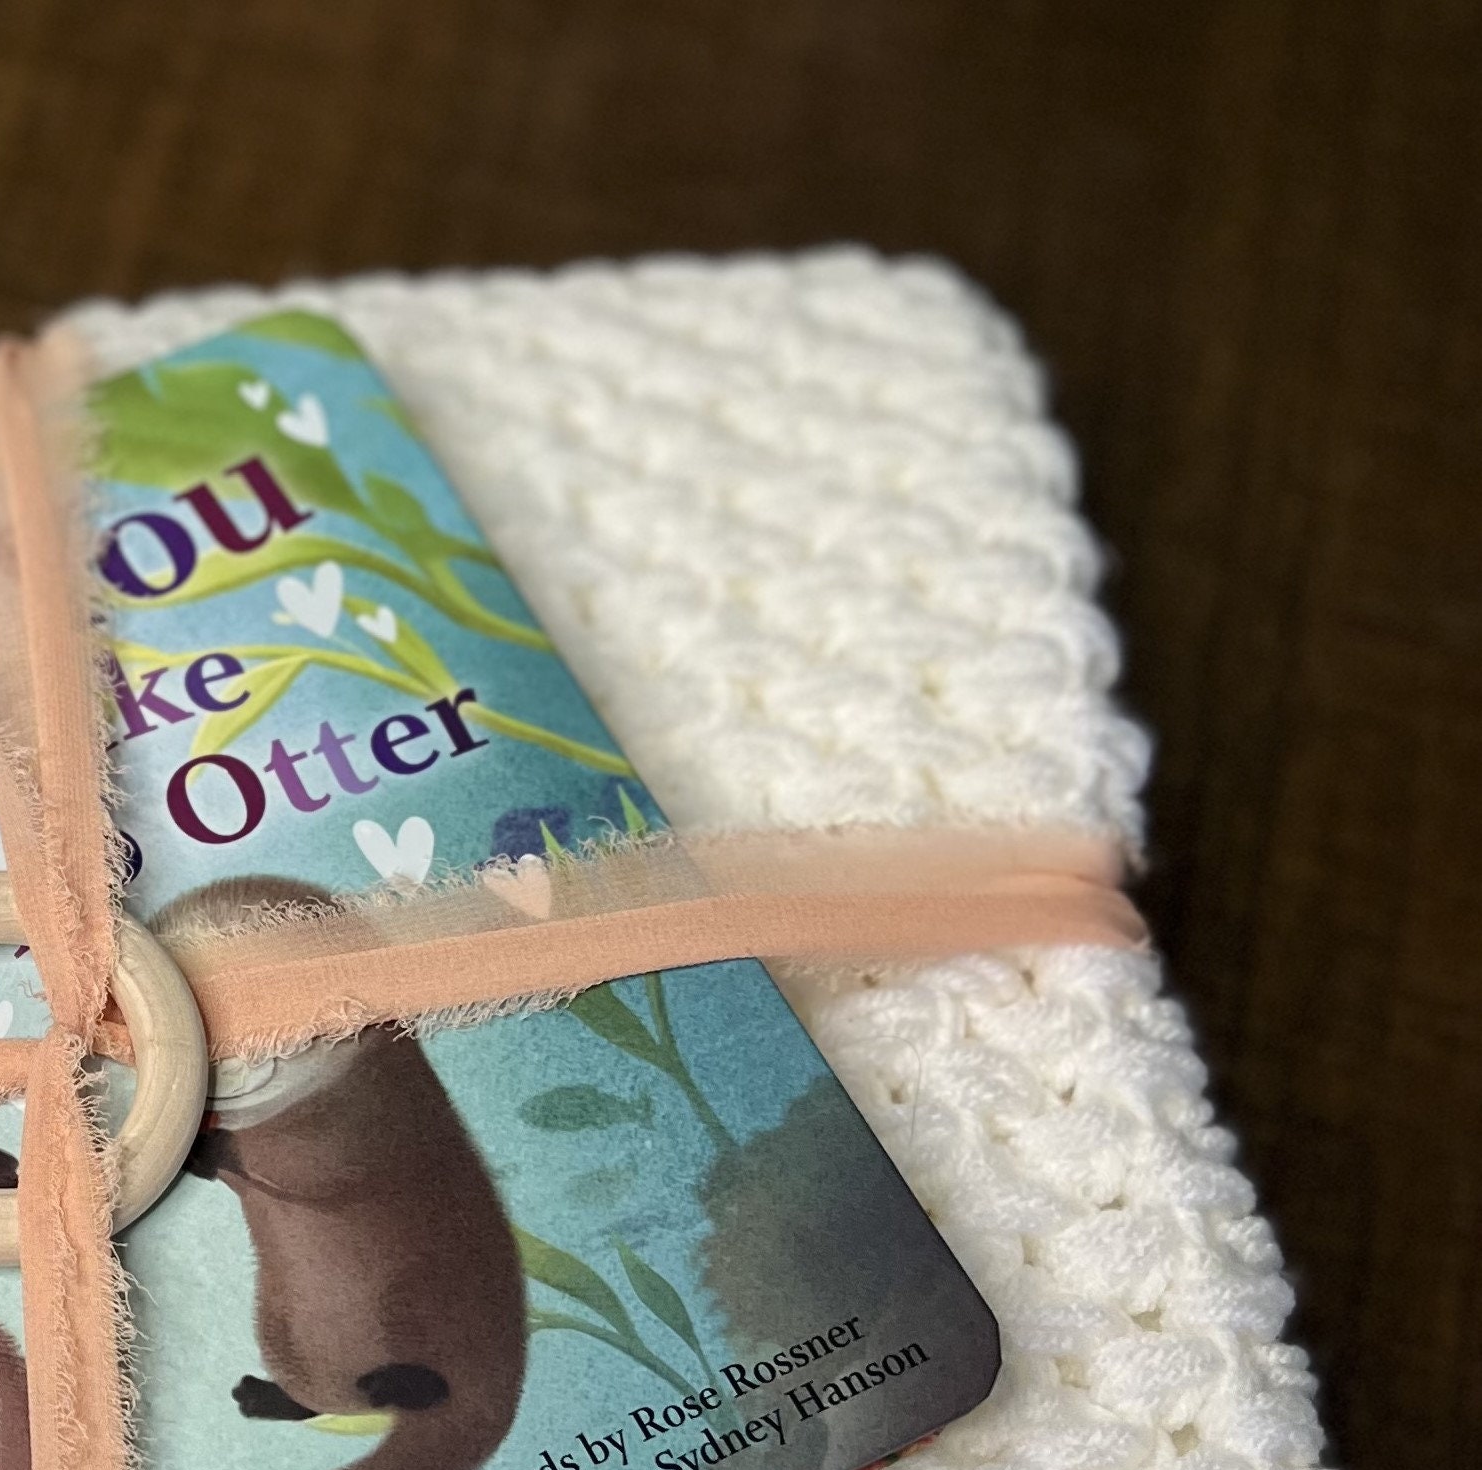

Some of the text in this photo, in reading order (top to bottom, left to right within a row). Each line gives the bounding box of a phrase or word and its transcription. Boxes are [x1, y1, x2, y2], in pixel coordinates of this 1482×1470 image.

[92, 455, 314, 599] ou
[166, 681, 490, 844] Otter
[577, 1429, 630, 1466] by
[629, 1387, 722, 1442] Rose
[720, 1314, 865, 1398] Rossner
[786, 1343, 930, 1421] Hanson
